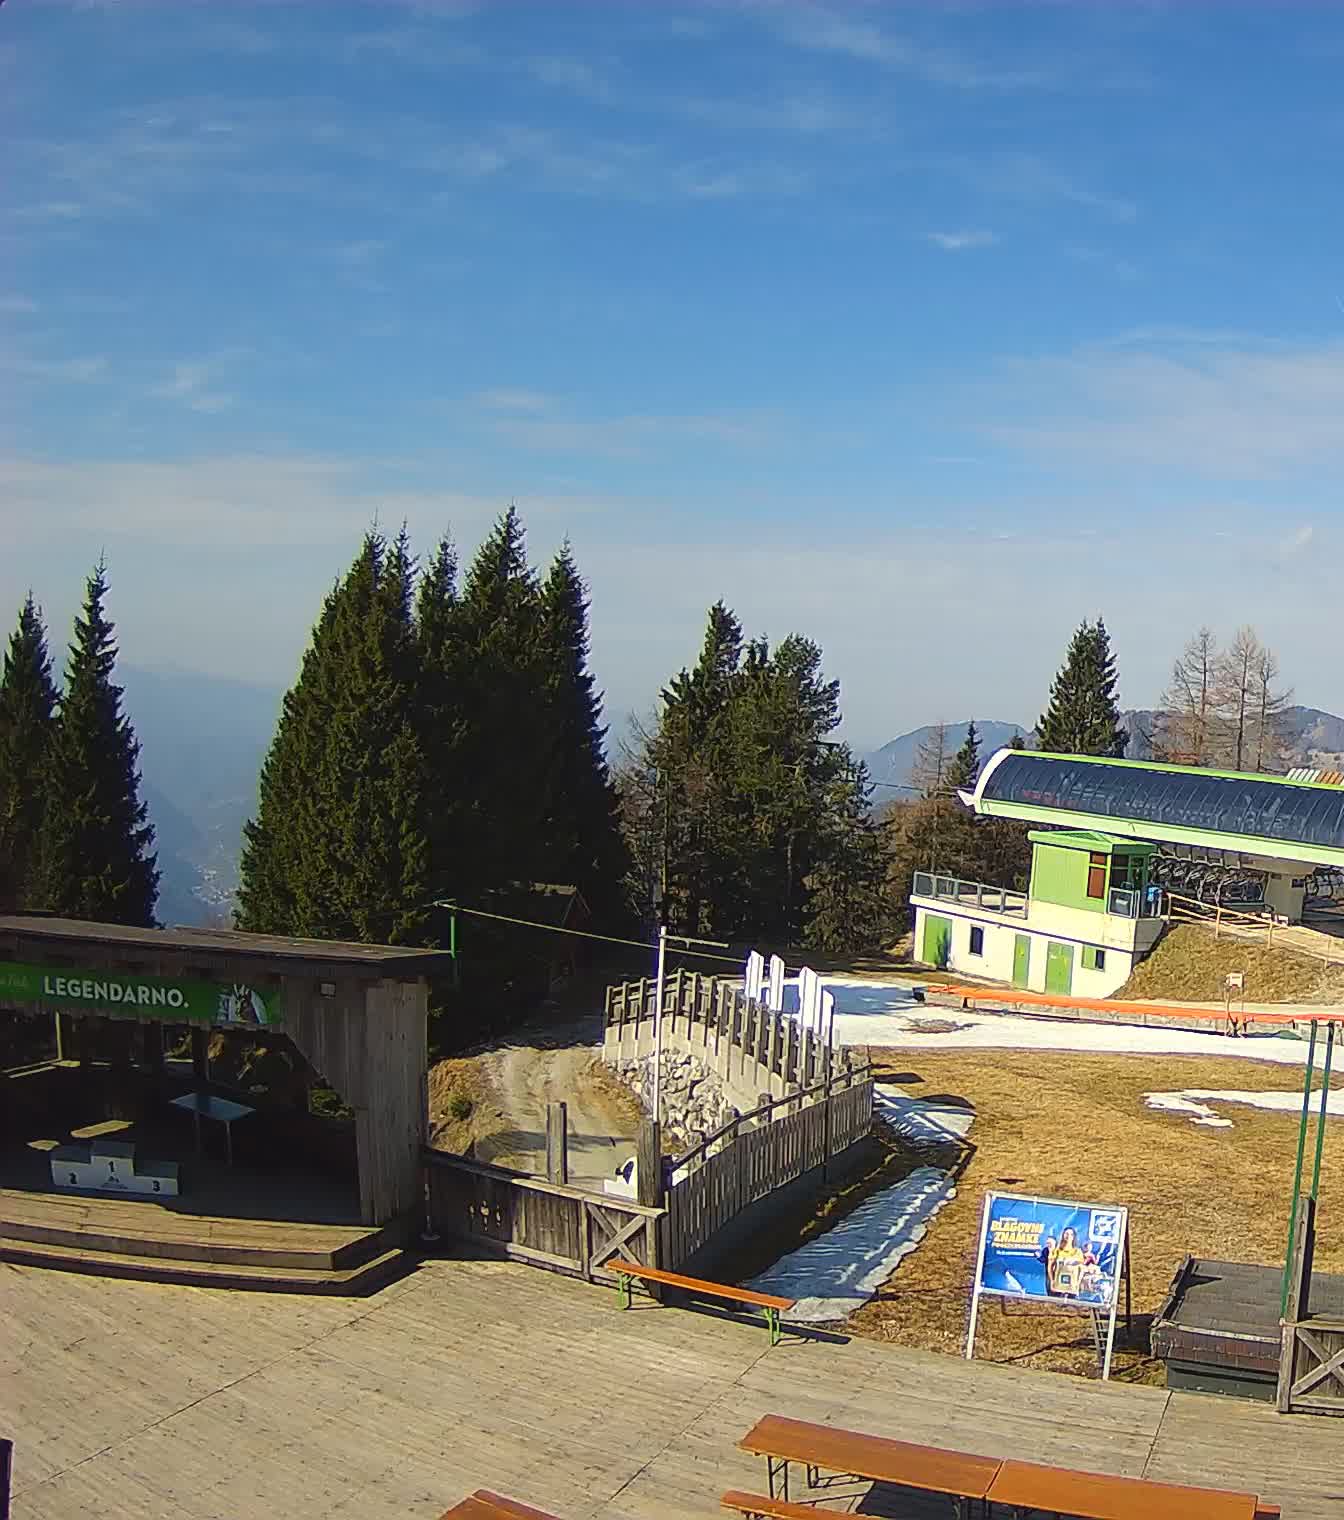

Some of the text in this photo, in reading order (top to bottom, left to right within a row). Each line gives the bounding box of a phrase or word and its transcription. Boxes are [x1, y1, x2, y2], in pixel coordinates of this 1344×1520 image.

[44, 975, 189, 1008] LEGENDARNO.
[108, 1160, 116, 1173] 1
[151, 1180, 161, 1192] 3
